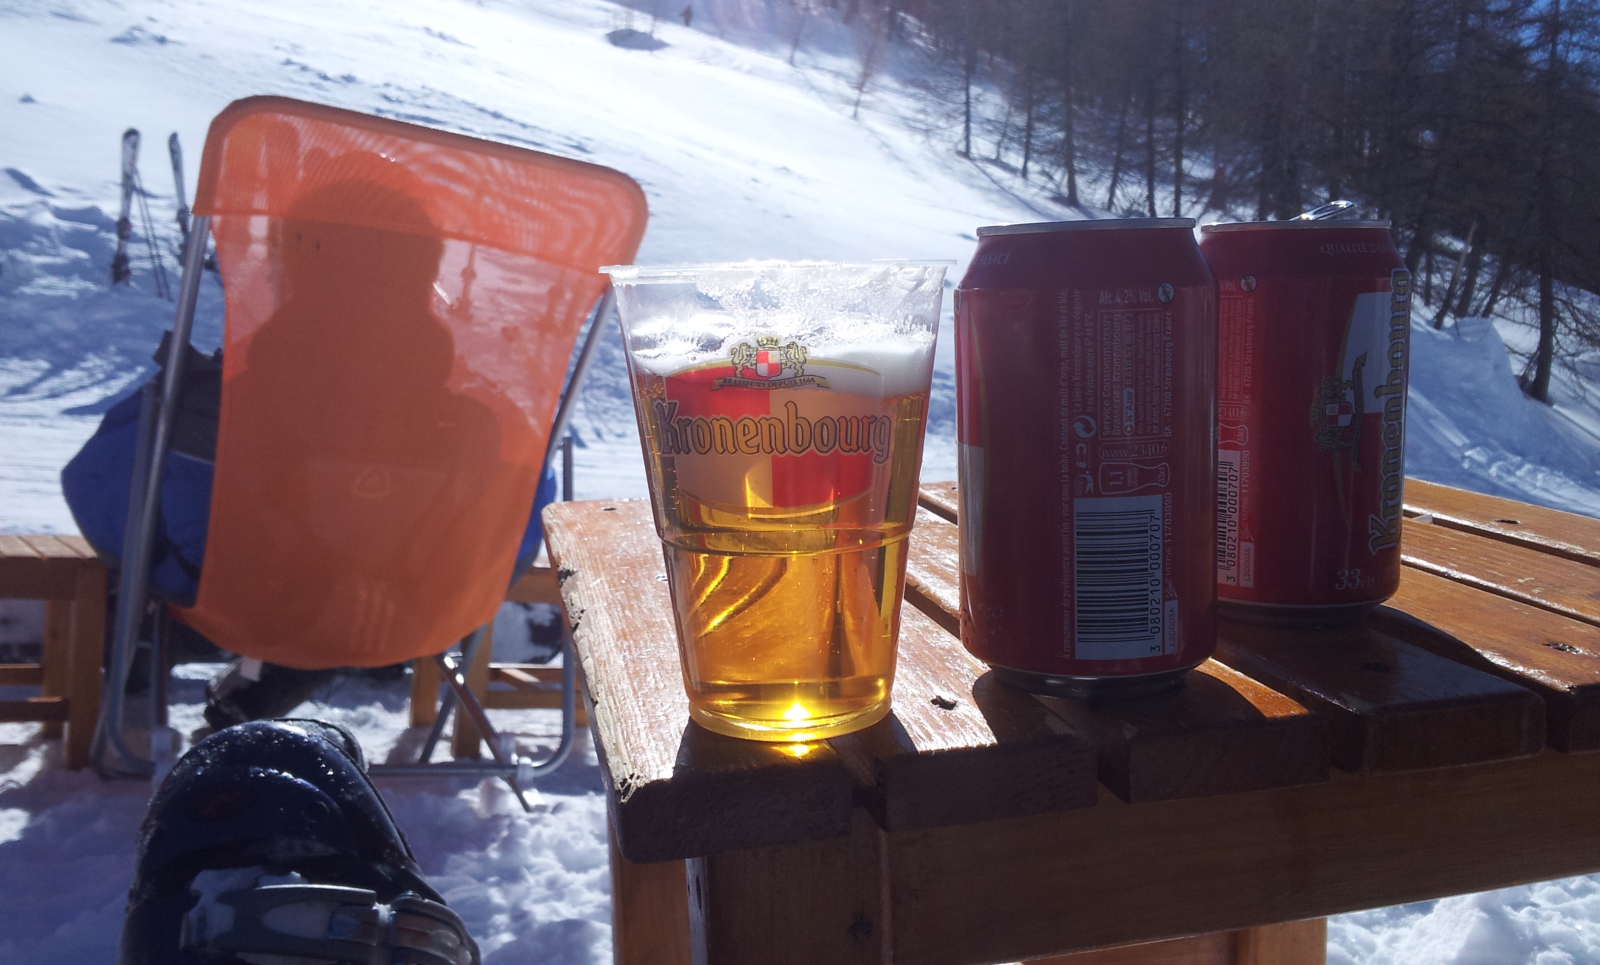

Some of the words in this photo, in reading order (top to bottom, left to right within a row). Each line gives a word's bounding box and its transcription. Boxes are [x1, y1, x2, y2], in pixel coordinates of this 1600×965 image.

[1059, 329, 1068, 338] de
[1164, 308, 1172, 340] France.
[1059, 340, 1068, 358] malt
[1072, 333, 1083, 380] Kronenbourg
[1102, 314, 1111, 397] Consommateurs
[1112, 314, 1122, 381] Kronenbourg
[1245, 325, 1254, 364] Strasbourg
[1164, 342, 1174, 390] Strasbourg
[1244, 366, 1252, 387] 67200
[768, 378, 798, 388] DEPUIS
[1059, 388, 1068, 406] malt
[1073, 404, 1081, 412] La
[1112, 384, 1121, 435] Brasseries
[1164, 392, 1172, 417] 67200
[1243, 394, 1251, 404] BK
[1060, 408, 1068, 416] du
[1102, 400, 1111, 436] Service
[1364, 271, 1410, 553] Kronenbourg
[655, 400, 893, 464] Kronenbourg
[1164, 425, 1172, 437] BK
[1060, 474, 1069, 482] la
[1109, 471, 1123, 486] 1.1
[1158, 467, 1166, 483] 33cl
[1241, 450, 1249, 493] 11703990
[1228, 467, 1238, 513] 000707
[1060, 502, 1070, 517] voir
[1164, 492, 1172, 543] 11703990
[1061, 534, 1070, 554] avant
[1150, 515, 1160, 570] 000707
[1227, 520, 1237, 567] 080210
[1061, 598, 1070, 608] de
[1150, 579, 1160, 634] 080210
[1150, 645, 1160, 653] 3
